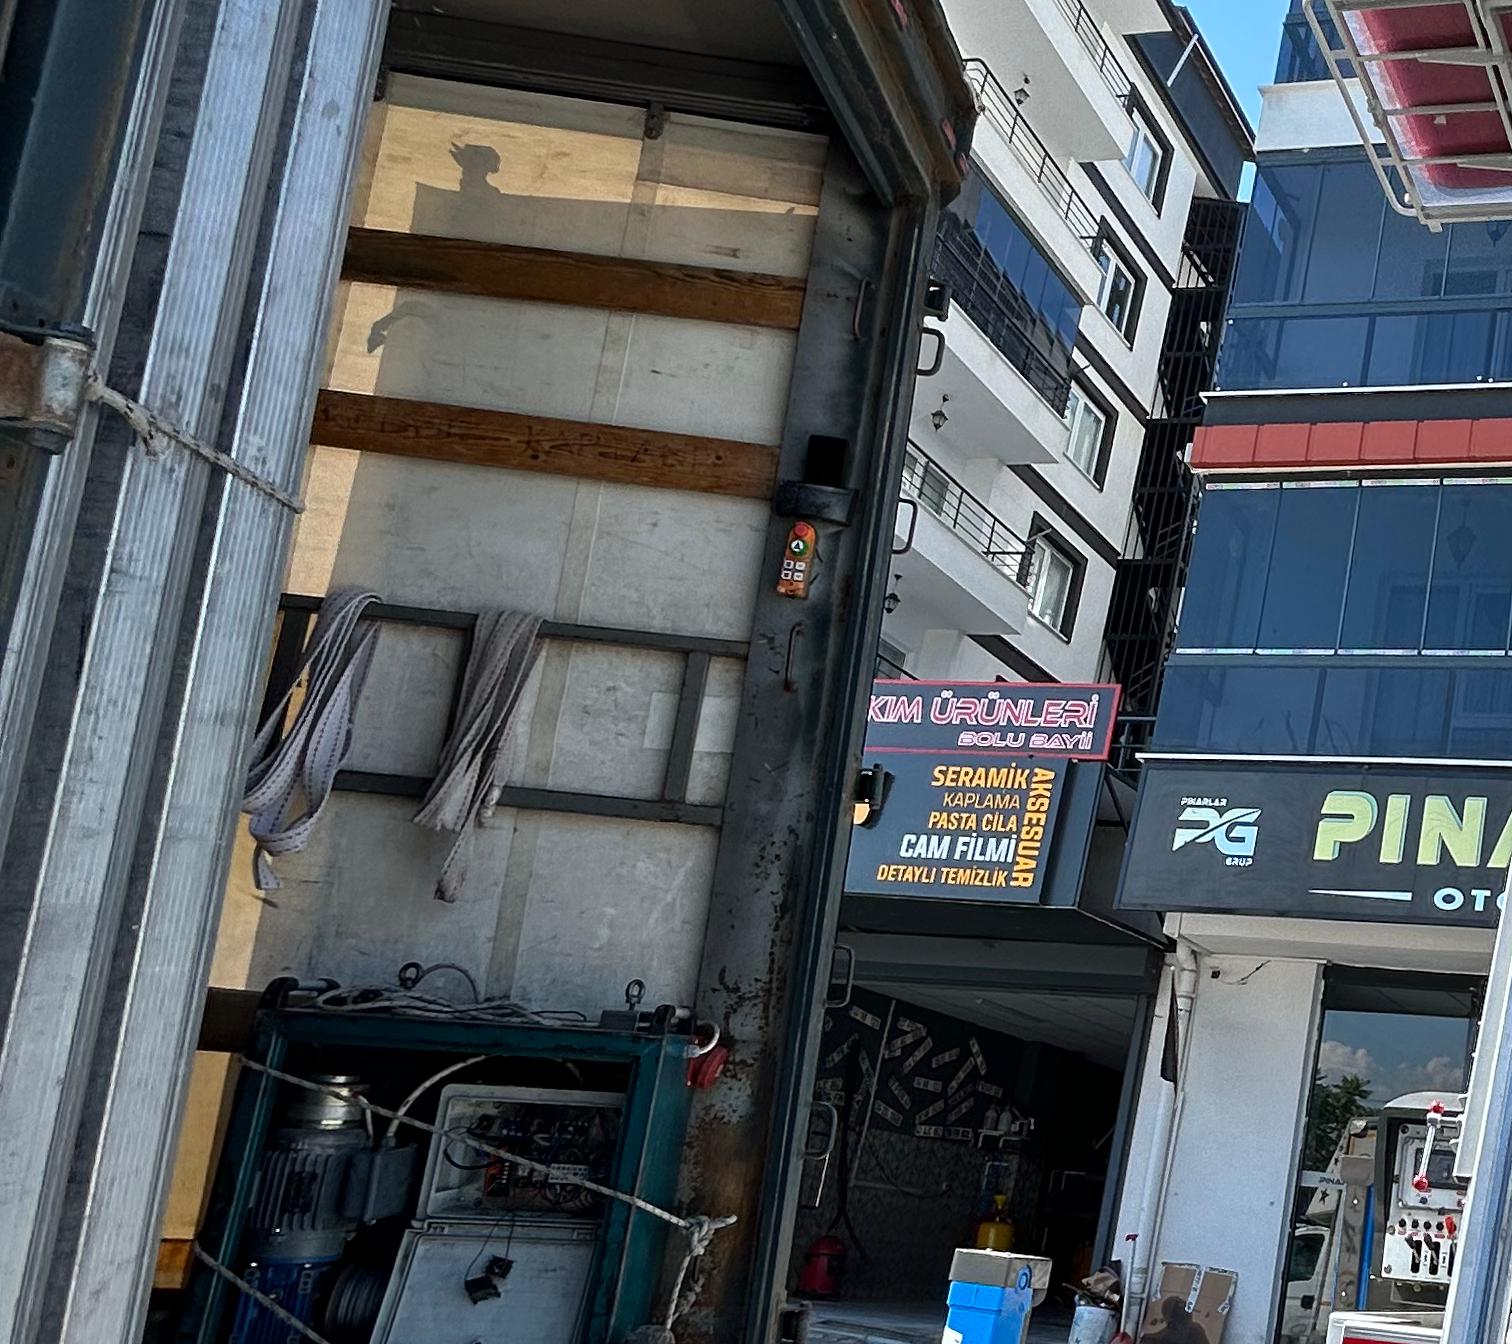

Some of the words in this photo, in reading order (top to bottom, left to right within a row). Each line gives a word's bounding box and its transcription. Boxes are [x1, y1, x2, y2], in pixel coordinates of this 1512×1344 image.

[930, 690, 1099, 728] ÜRÜNLERİ
[957, 732, 1026, 747] BOLU
[931, 762, 1031, 790] SERAMİK
[942, 791, 1021, 810] KAPLAMA
[928, 811, 978, 831] PASTA
[981, 812, 1018, 832] CİLA
[1010, 767, 1056, 888] AKSESUAR
[899, 833, 950, 860] CAM
[953, 831, 1018, 864] FİLMİ
[1225, 857, 1254, 867] GRUP
[876, 864, 936, 884] DETAYLI
[940, 865, 1009, 888] TEMİZLİK
